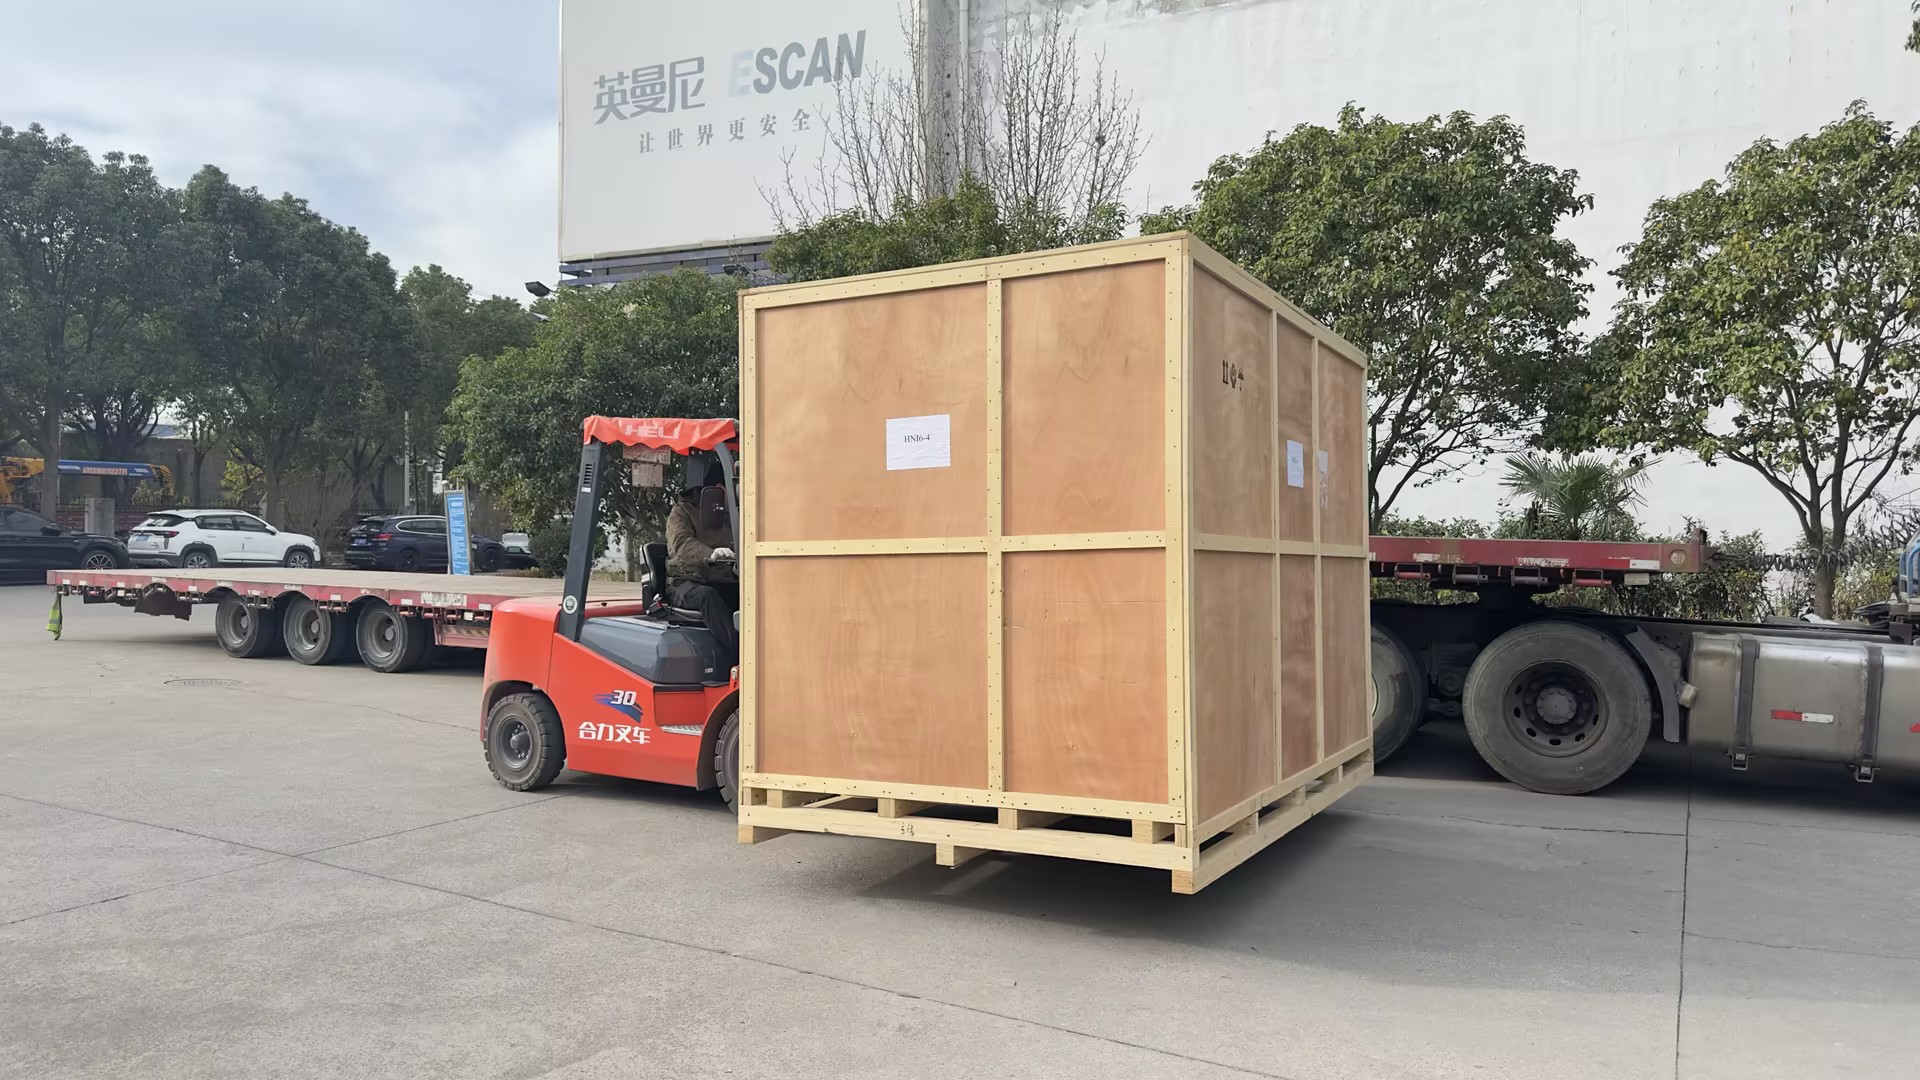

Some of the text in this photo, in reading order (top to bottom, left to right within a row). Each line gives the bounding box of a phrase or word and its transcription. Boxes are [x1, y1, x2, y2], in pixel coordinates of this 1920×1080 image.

[727, 29, 867, 98] ESCAN
[593, 56, 706, 125] 英曼尼
[639, 108, 811, 154] 让世界更安全
[625, 424, 681, 440] HELI
[610, 689, 637, 706] 30
[578, 721, 652, 745] 合力叉车
